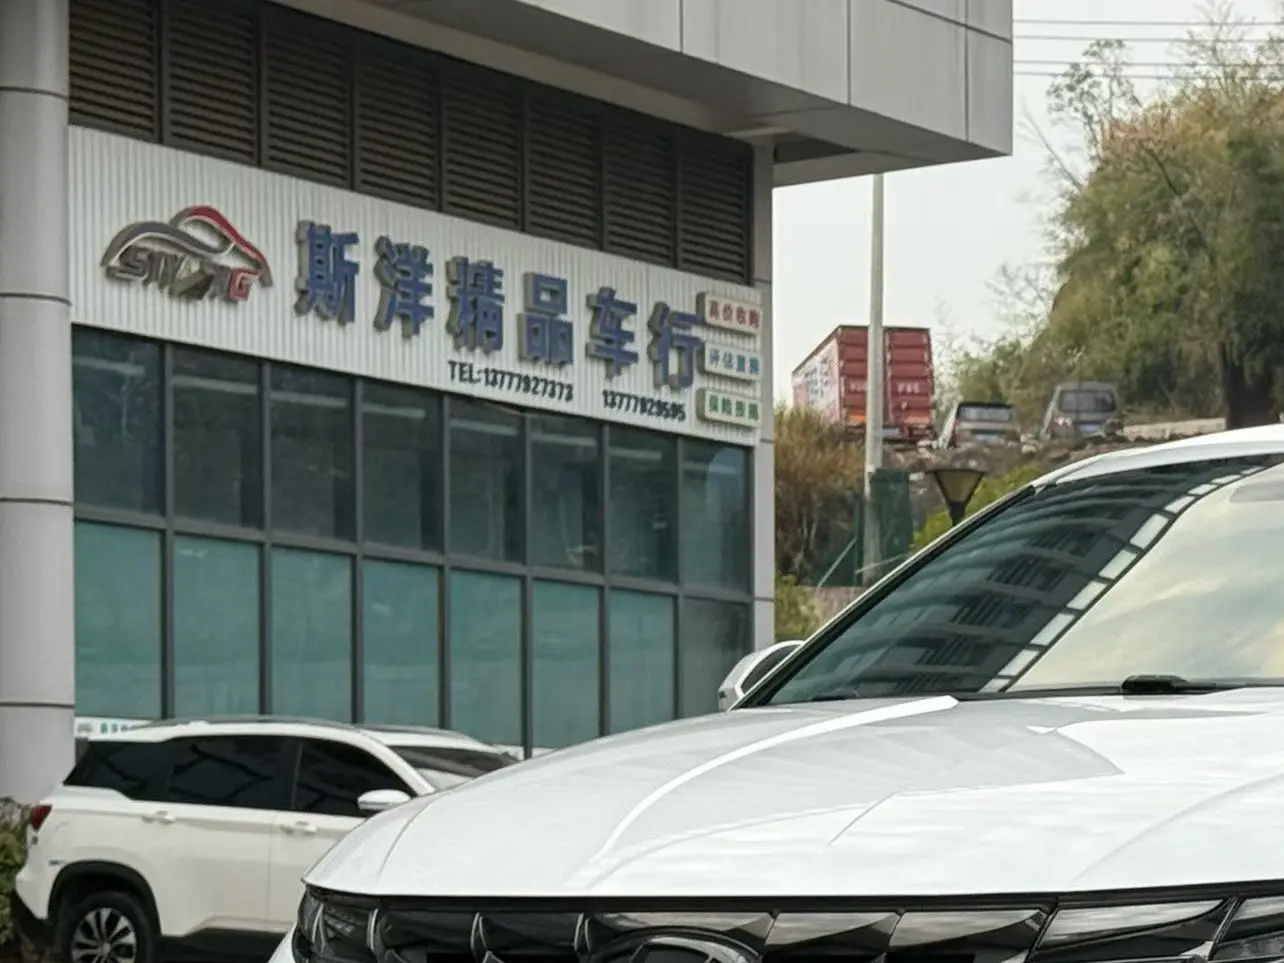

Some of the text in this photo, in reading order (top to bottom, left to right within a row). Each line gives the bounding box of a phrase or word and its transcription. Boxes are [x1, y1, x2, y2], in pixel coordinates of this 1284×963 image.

[294, 220, 705, 391] 斯洋精品车行
